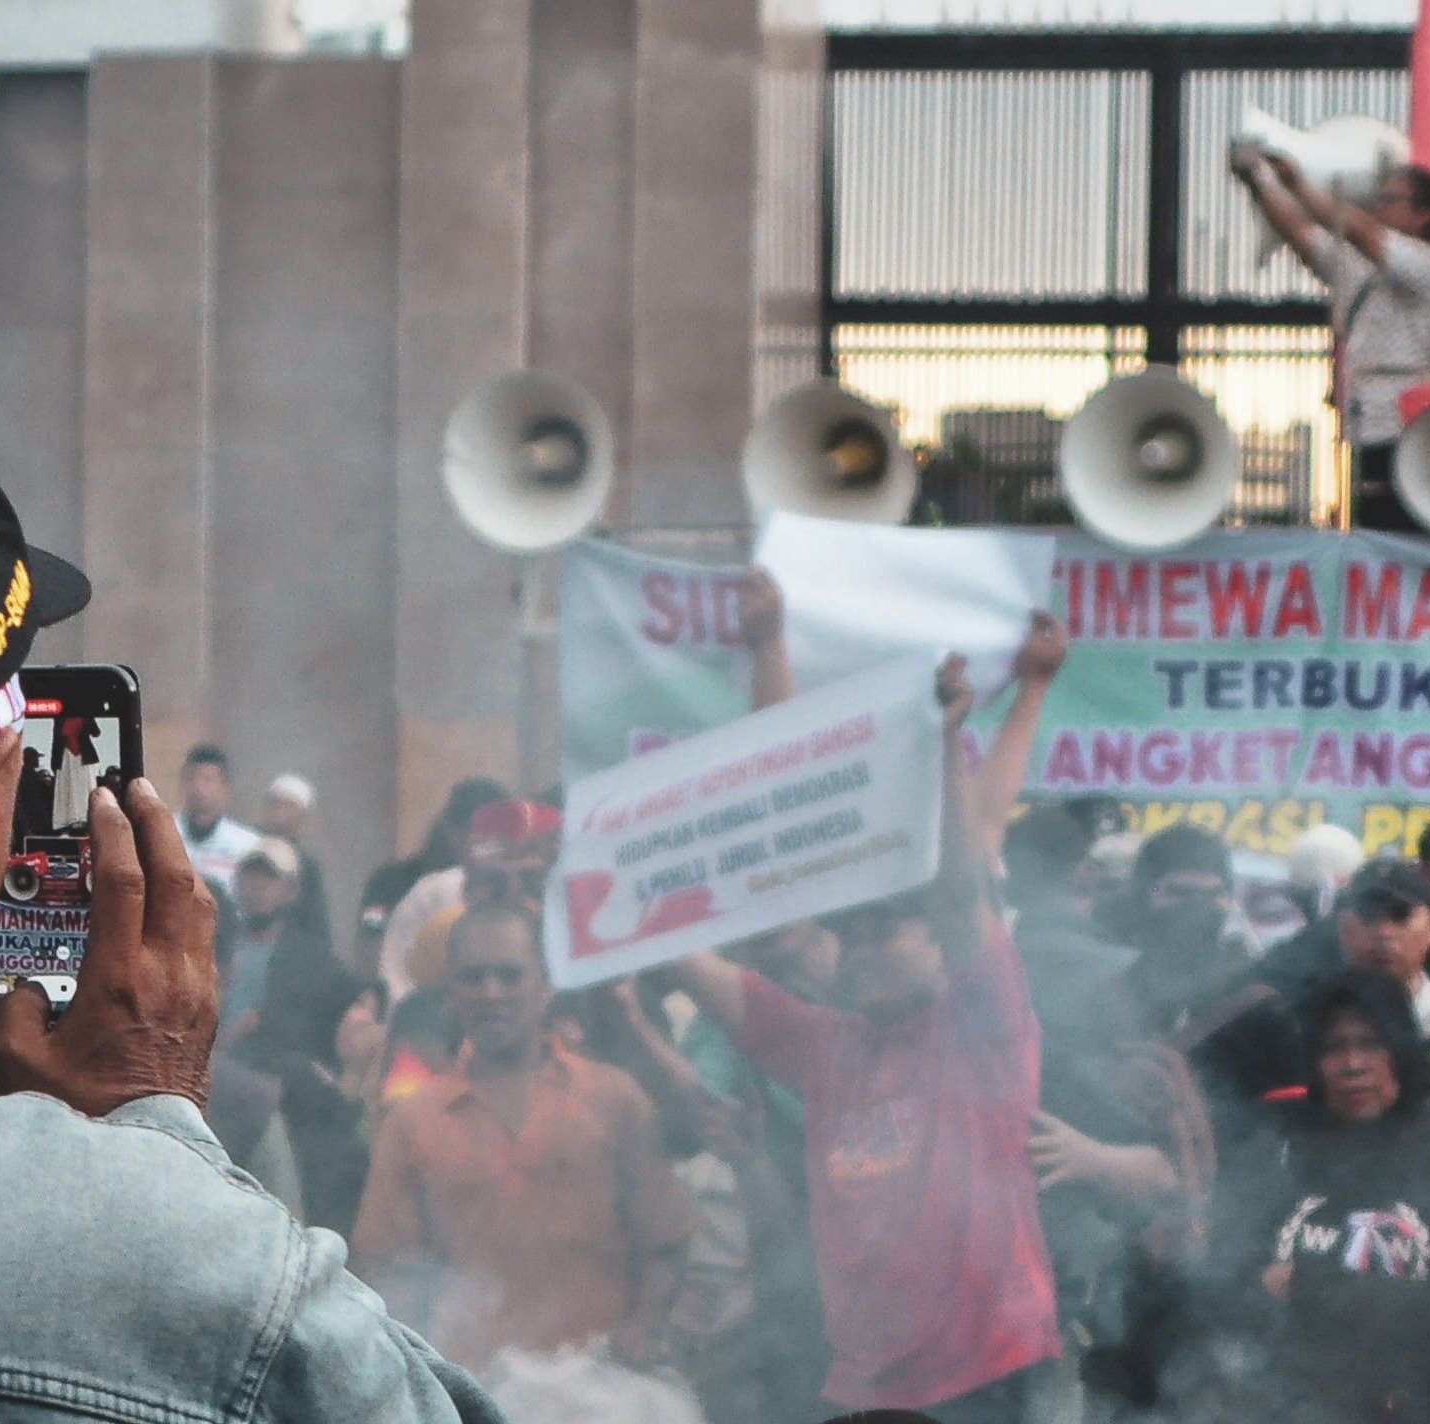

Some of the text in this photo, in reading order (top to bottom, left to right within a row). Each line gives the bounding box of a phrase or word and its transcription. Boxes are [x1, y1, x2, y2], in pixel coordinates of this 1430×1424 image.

[1053, 559, 1323, 640] IMEWA
[1043, 728, 1299, 786] ANGKET
[772, 760, 869, 812] DEMOKRASI
[773, 808, 864, 854] INDONESIA
